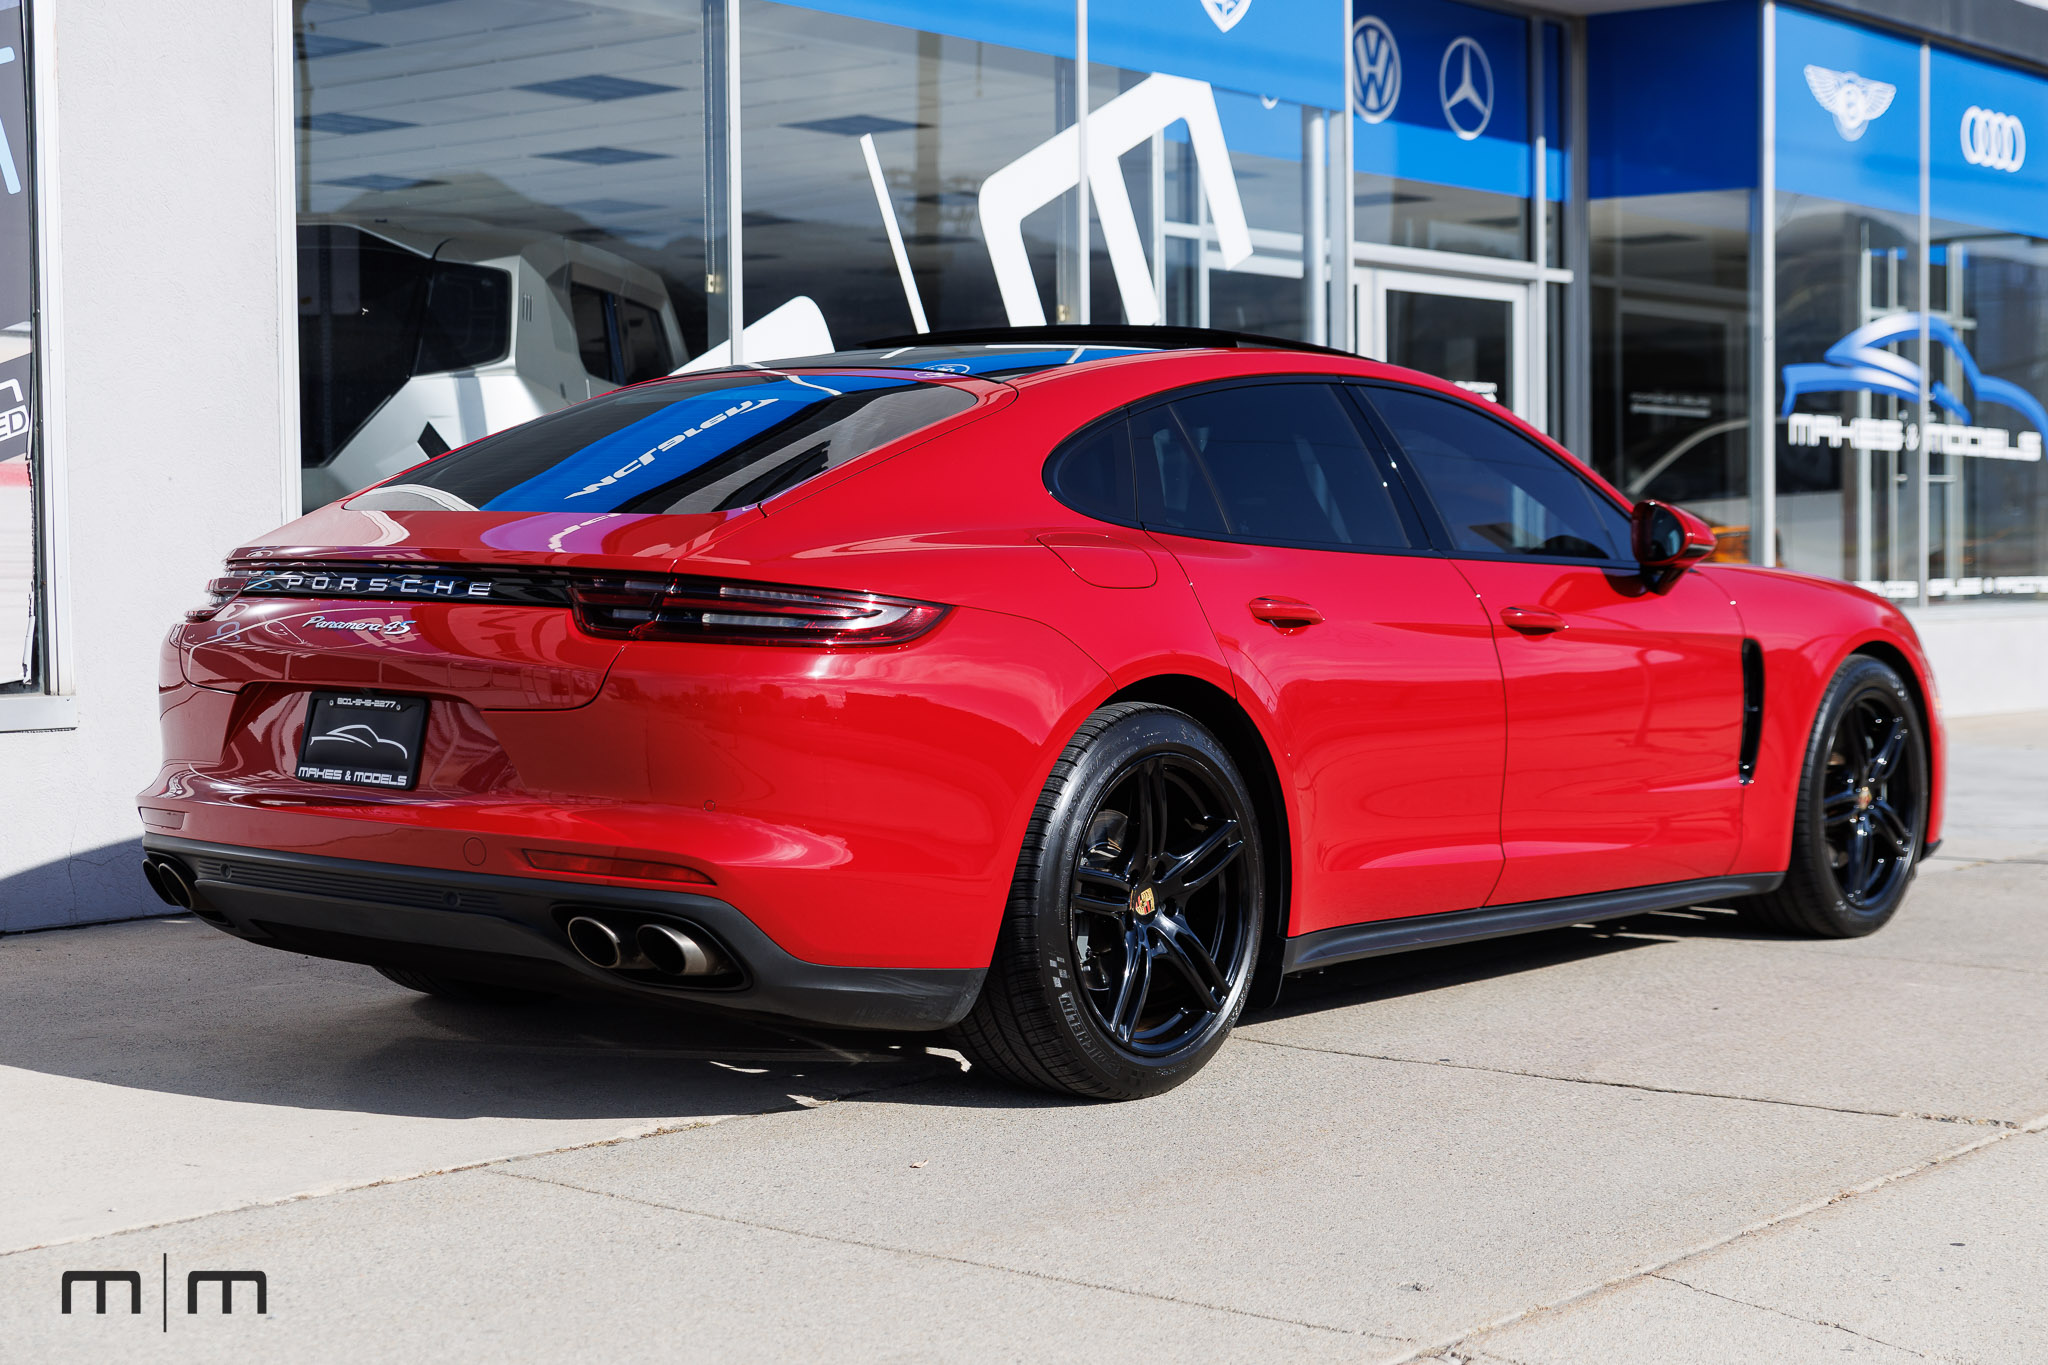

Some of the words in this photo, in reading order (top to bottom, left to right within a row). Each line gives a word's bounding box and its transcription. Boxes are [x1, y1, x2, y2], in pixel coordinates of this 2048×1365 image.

[1788, 413, 1904, 451] MAKES
[1905, 423, 1919, 451] &
[1923, 423, 2042, 462] MODELS
[287, 576, 492, 596] PORSCHE
[302, 615, 382, 631] Panamera
[383, 620, 417, 635] 4S
[298, 766, 343, 780] MAKES
[344, 770, 352, 781] &
[353, 771, 408, 786] MODELS
